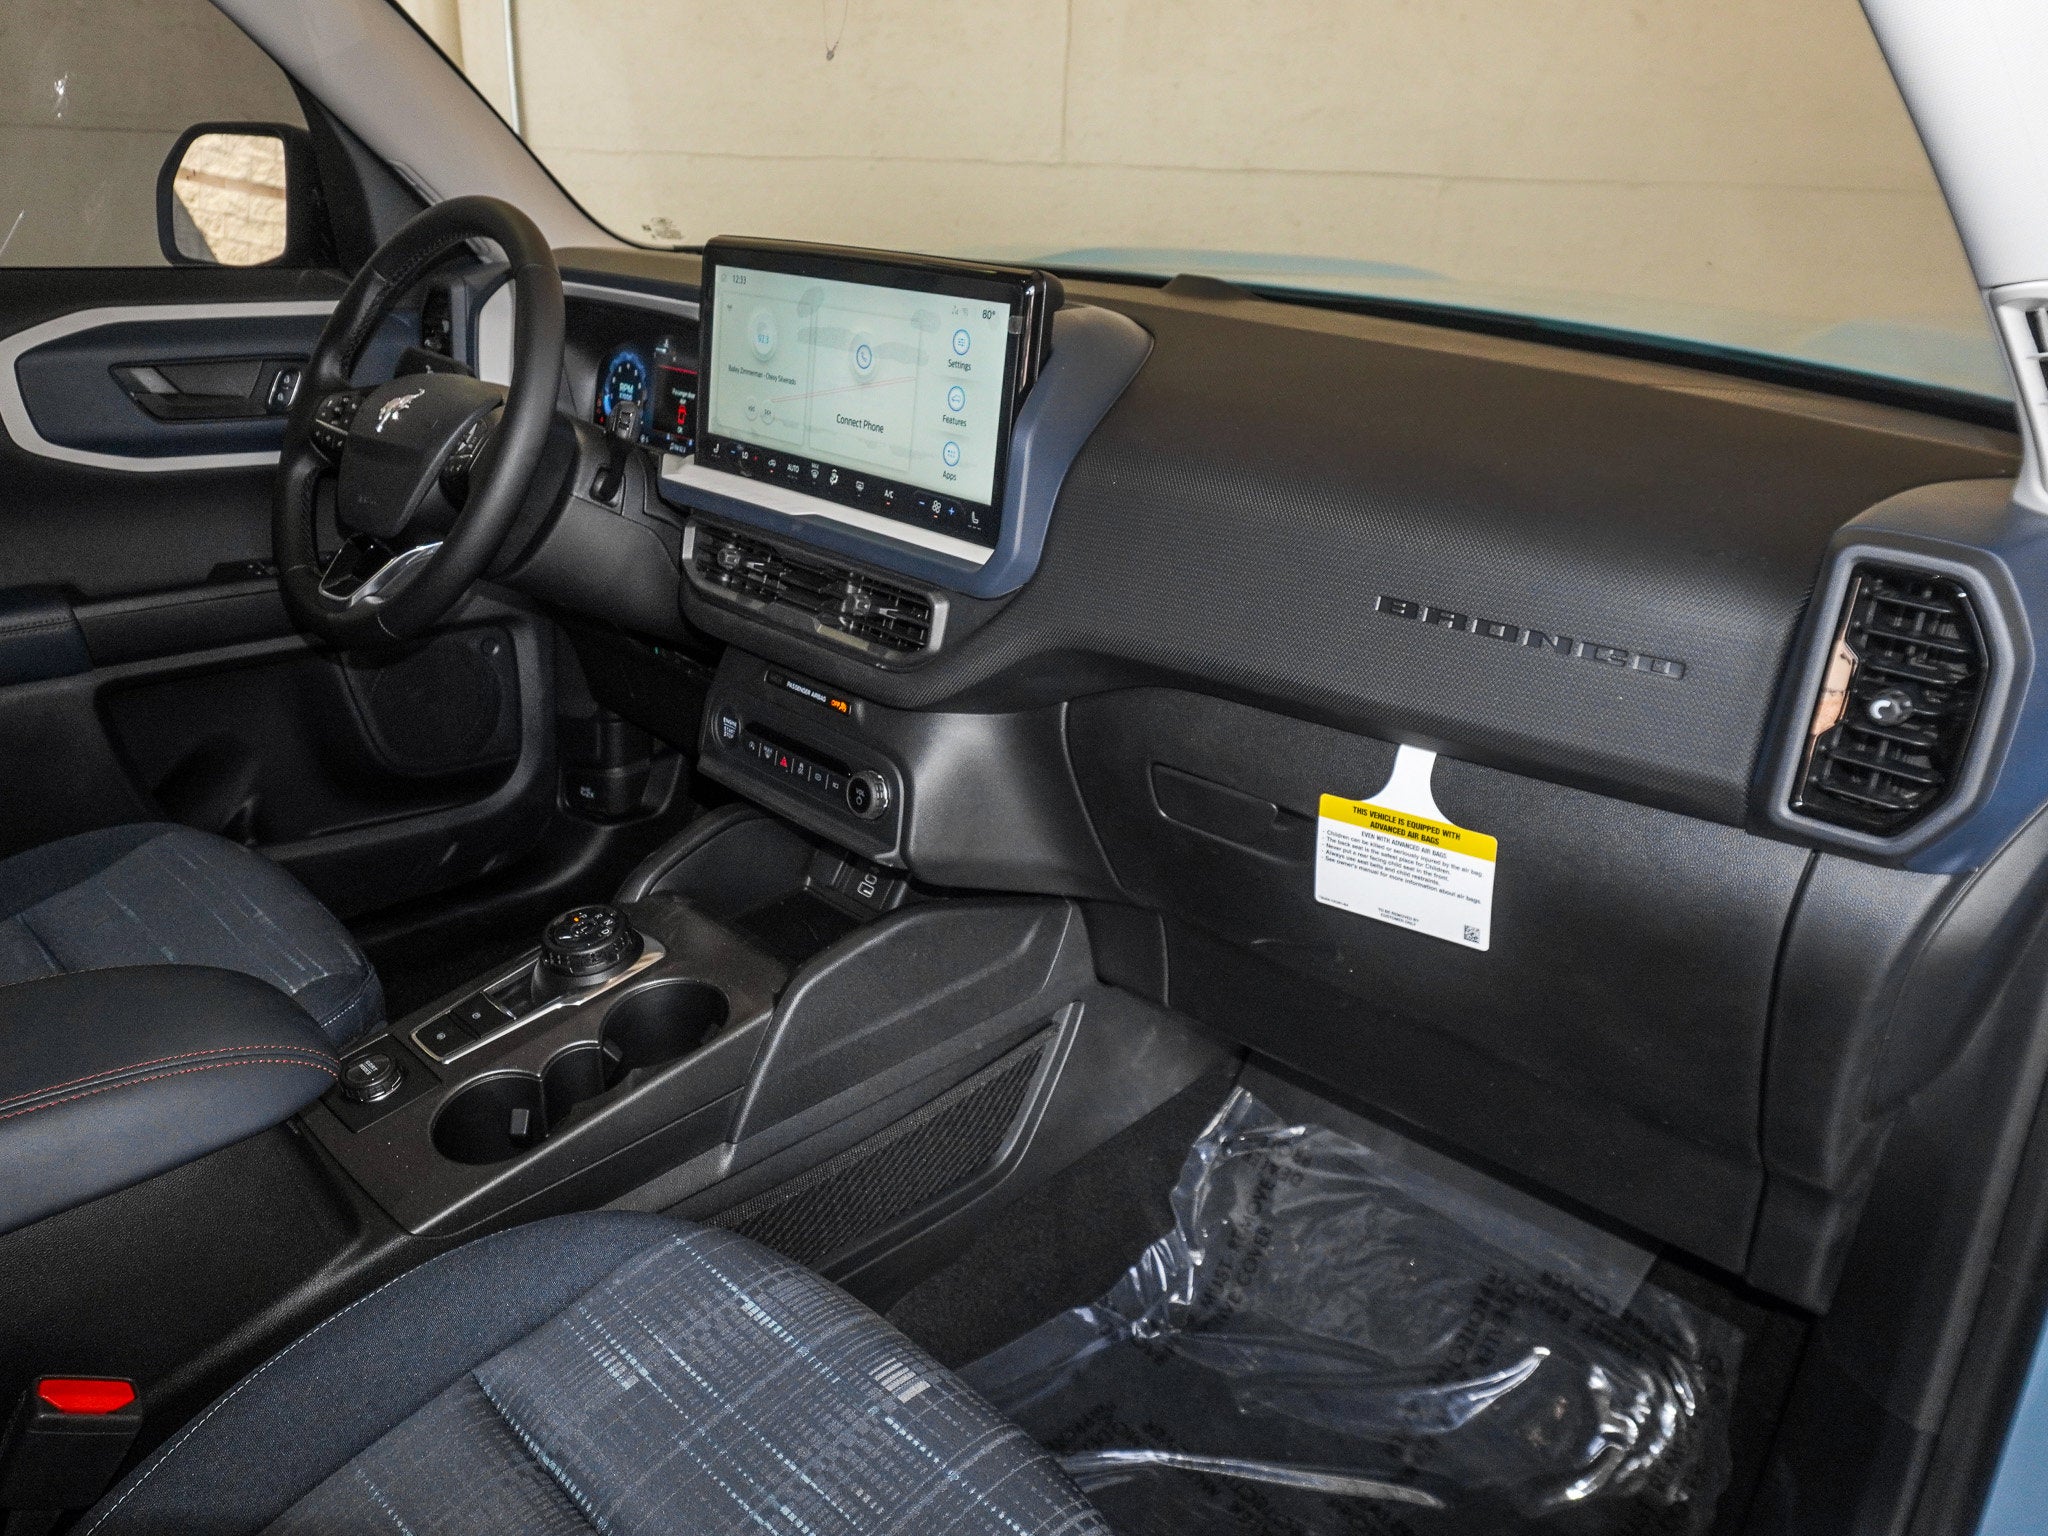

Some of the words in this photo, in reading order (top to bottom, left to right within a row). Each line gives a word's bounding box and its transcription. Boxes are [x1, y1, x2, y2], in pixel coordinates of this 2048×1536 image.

[948, 359, 972, 372] Settings
[836, 414, 862, 428] Connect
[864, 420, 884, 434] Phone
[942, 414, 966, 427] Features
[786, 464, 800, 473] AUTO
[942, 470, 956, 480] Apps
[1375, 596, 1686, 680] BRONCO
[786, 680, 811, 696] PASSENGER
[1353, 806, 1368, 816] THIS
[1370, 811, 1396, 824] VEHICLE
[1407, 820, 1440, 834] EQUIPPED
[1442, 830, 1461, 840] WITH
[1370, 821, 1405, 836] ADVANCED
[1408, 831, 1419, 839] AIR
[1421, 834, 1440, 845] BAGS
[1327, 830, 1349, 840] Children
[1370, 841, 1385, 850] killed
[1394, 848, 1419, 860] seriously
[1421, 857, 1440, 866] injured
[1377, 835, 1390, 843] WITH
[1392, 839, 1419, 851] ADVANCED
[1326, 850, 1344, 859] Always
[1370, 854, 1386, 864] facing
[1359, 866, 1379, 875] manual
[1405, 879, 1437, 892] information
